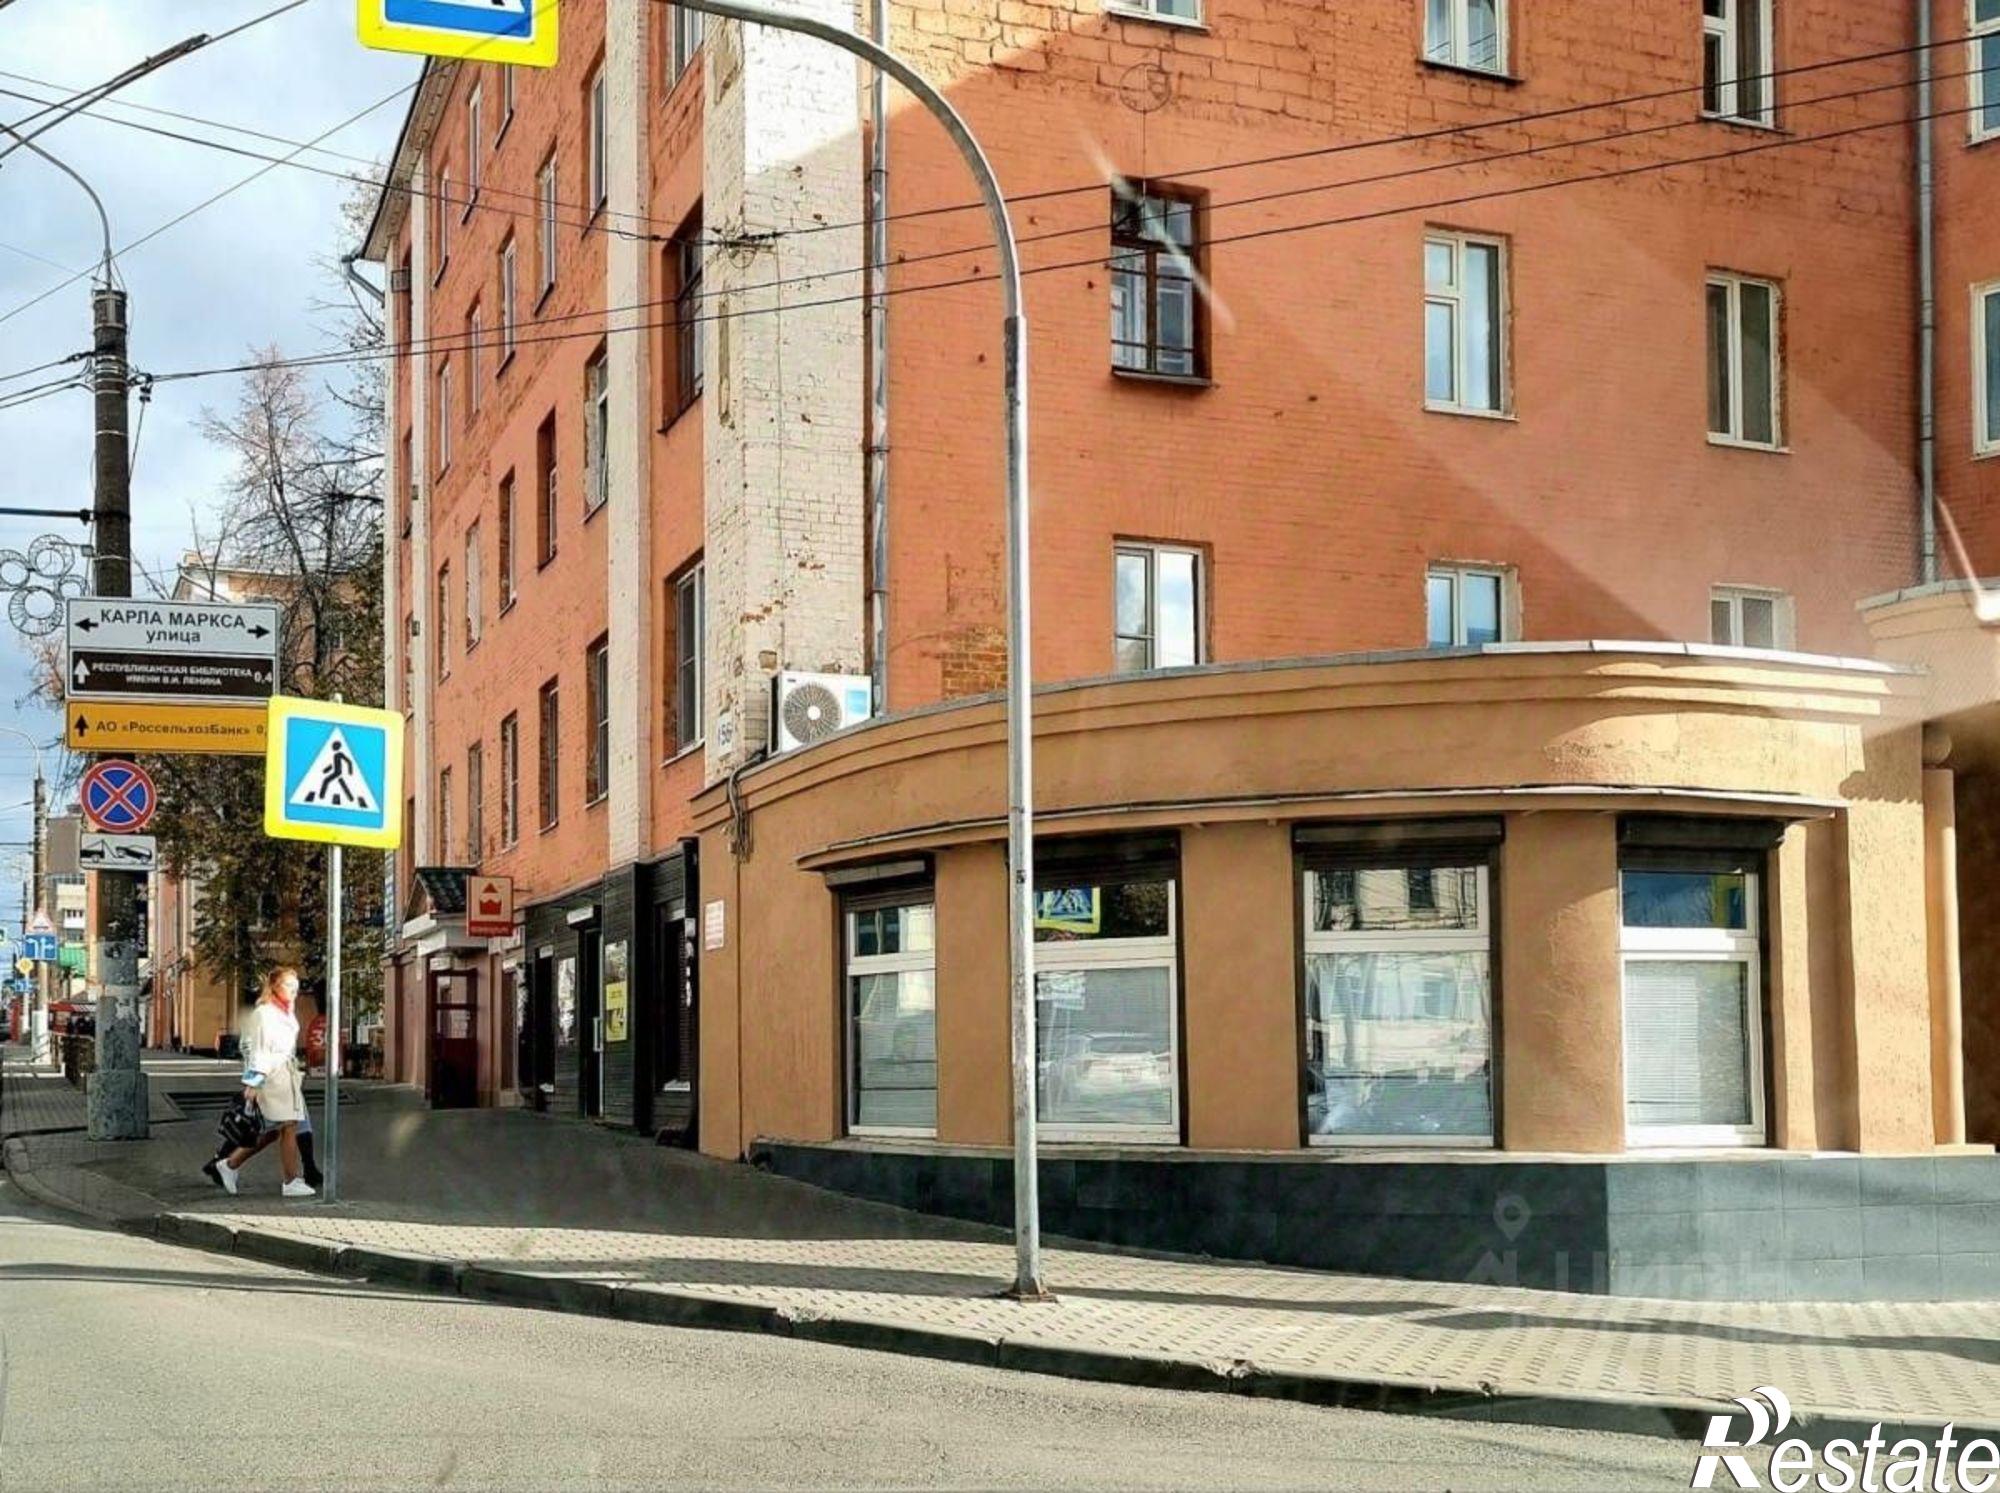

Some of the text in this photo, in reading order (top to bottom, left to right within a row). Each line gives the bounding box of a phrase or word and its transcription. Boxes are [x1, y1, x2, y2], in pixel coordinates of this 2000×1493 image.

[100, 609, 246, 629] КАРЛА МАРКСА
[146, 630, 201, 644] улица
[91, 662, 253, 677] РЕСПУБЛИКАНСКАЯ БИБЛИОТЕКА
[126, 675, 160, 684] ИМЕНИ
[182, 677, 222, 686] ЛЕНИНА
[96, 720, 117, 732] АО
